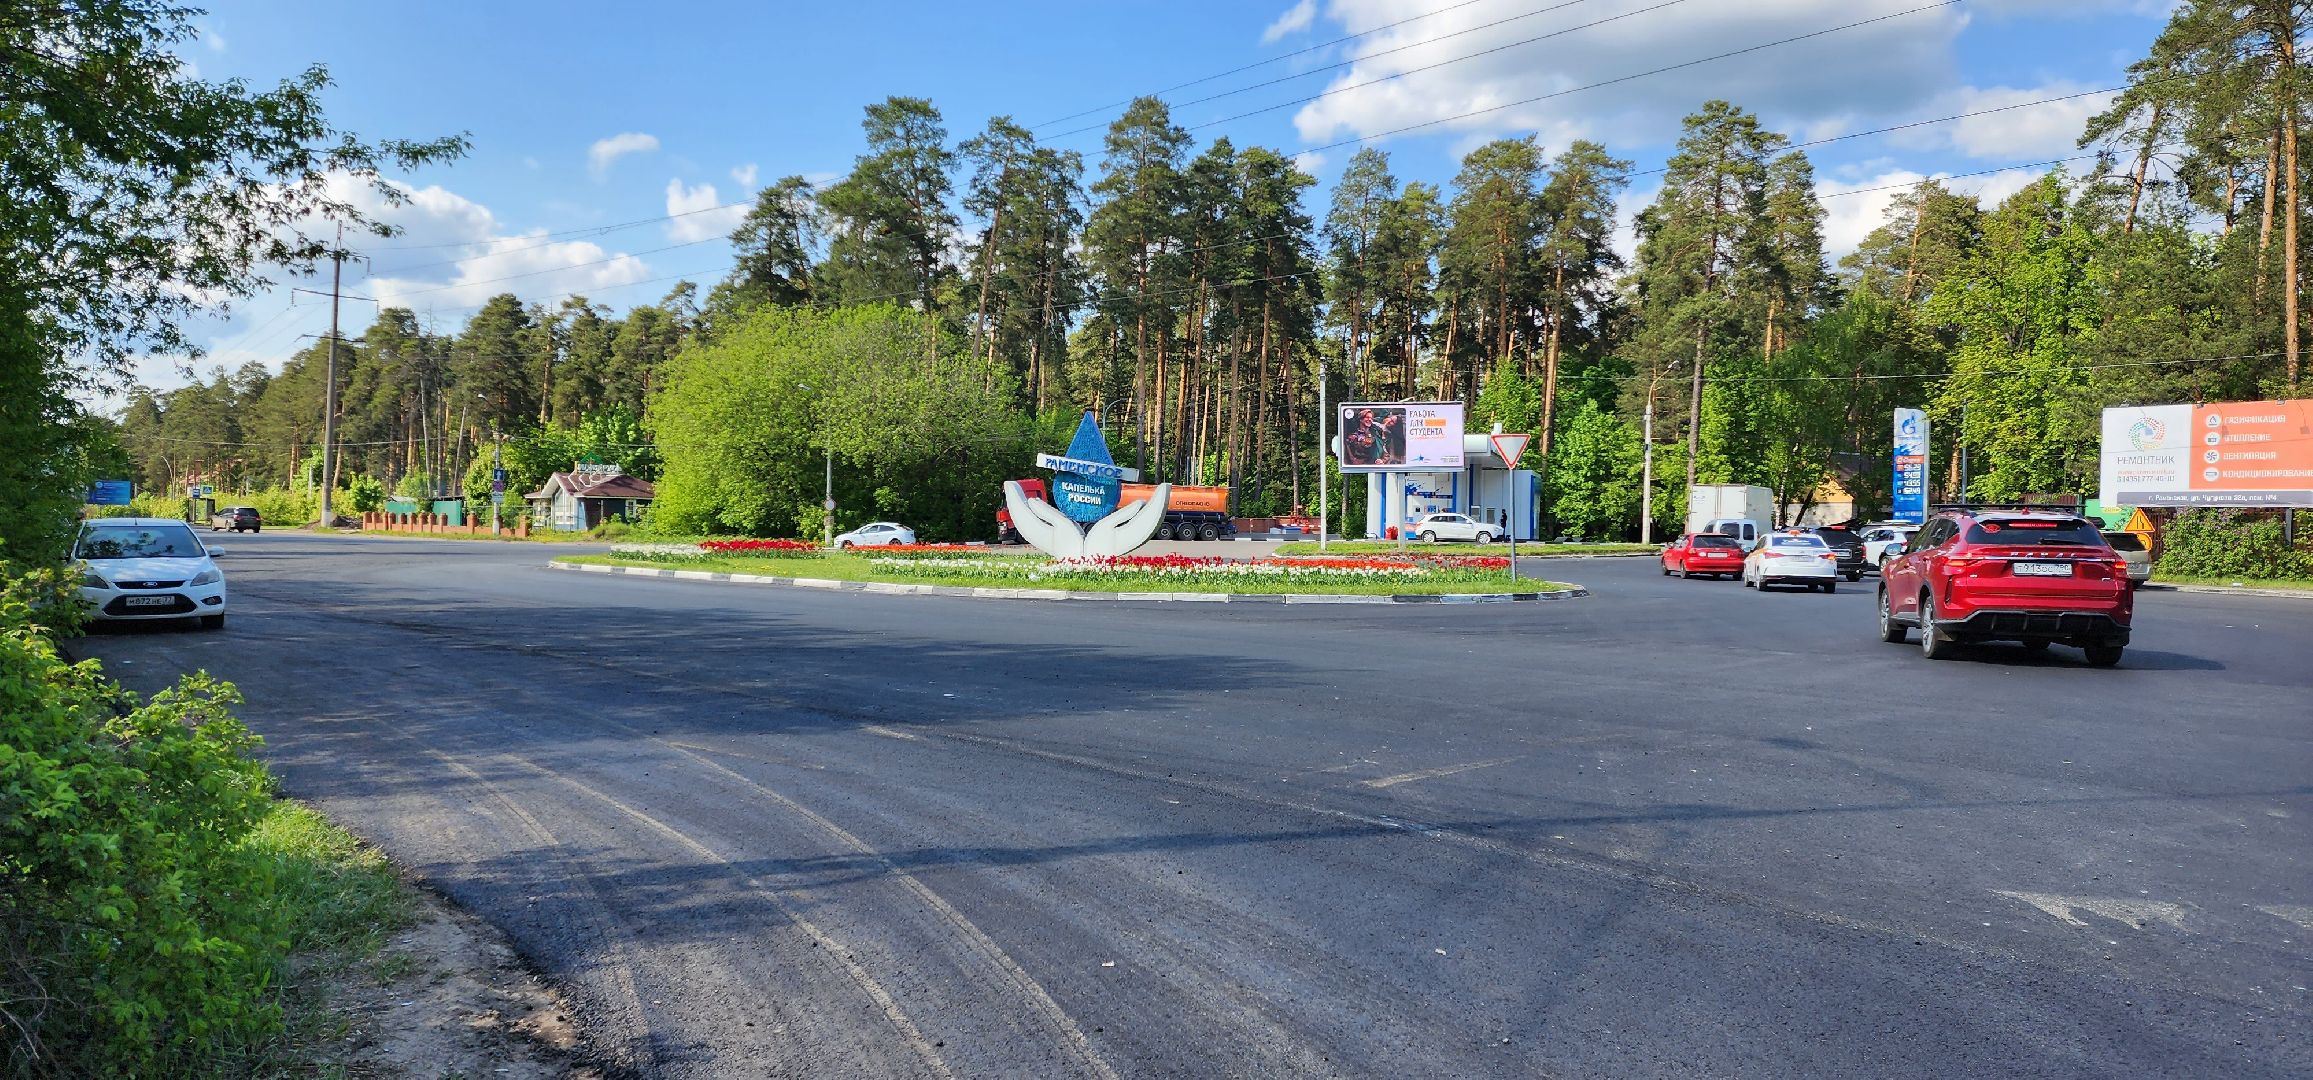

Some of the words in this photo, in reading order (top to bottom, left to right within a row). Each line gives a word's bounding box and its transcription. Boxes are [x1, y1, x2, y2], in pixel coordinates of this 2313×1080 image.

[2224, 415, 2286, 424] ГАЗИФИКАЦИЯ
[1409, 428, 1443, 436] СТУДЕНТА
[2117, 455, 2175, 465] РЕМОНТНИК
[2223, 451, 2277, 460] ВЕНТИЛЯЦИЯ
[1045, 457, 1122, 478] РАМЕНСКОЕ
[1061, 481, 1105, 495] КАПЕЛЬКА
[1068, 493, 1102, 505] РОССИИ
